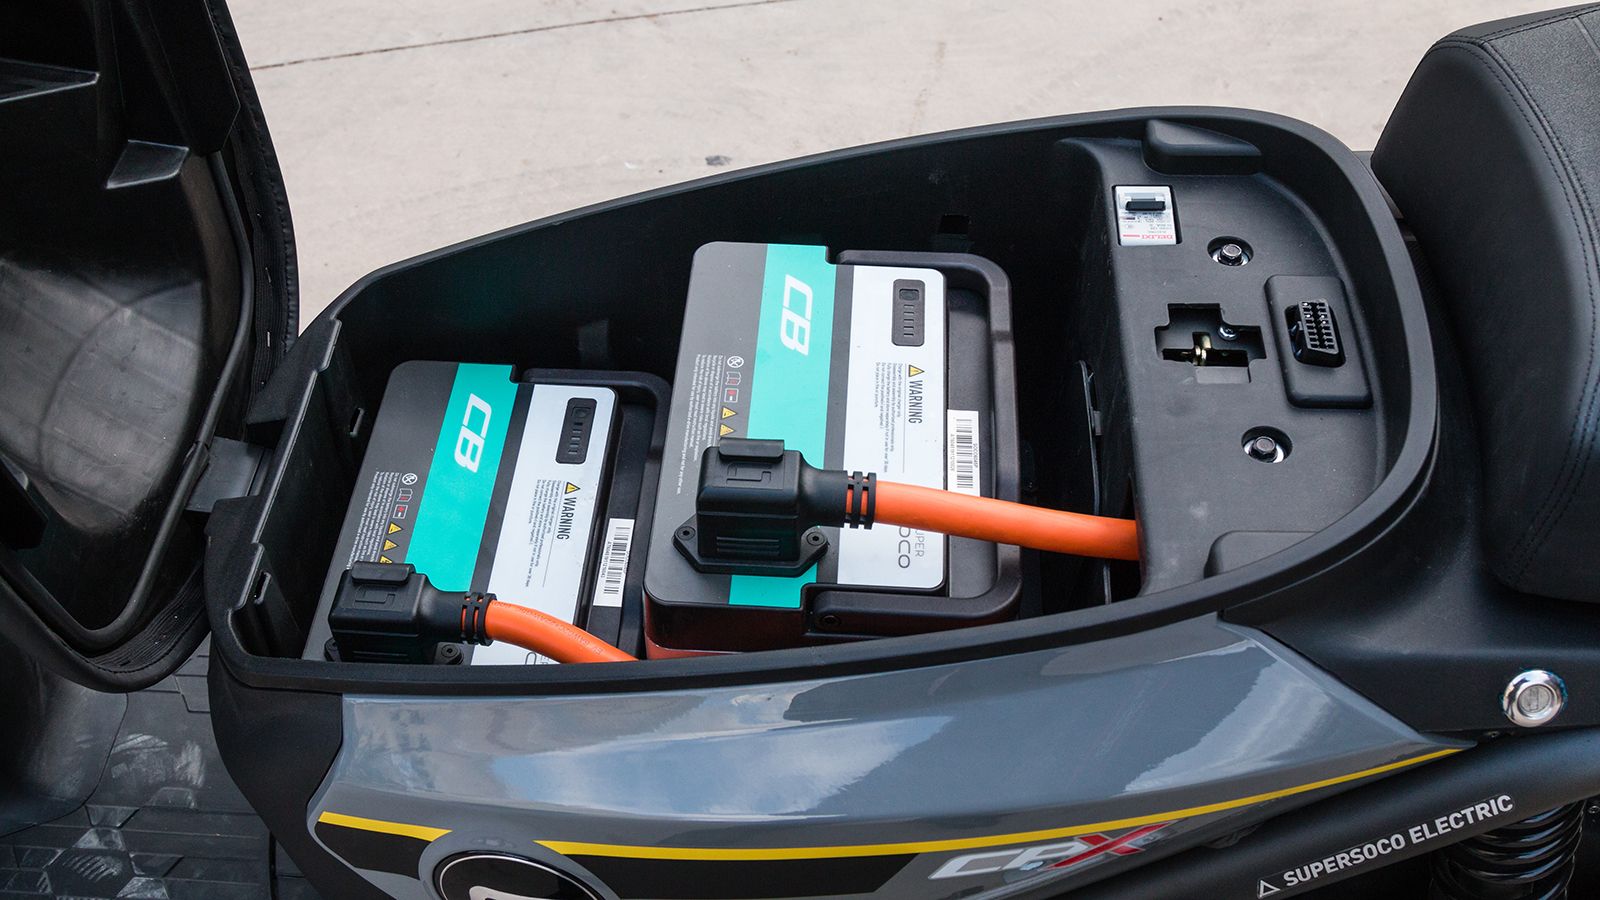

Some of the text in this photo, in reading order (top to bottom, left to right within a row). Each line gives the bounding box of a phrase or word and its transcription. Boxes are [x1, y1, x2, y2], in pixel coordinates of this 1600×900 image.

[780, 274, 814, 356] CB
[908, 380, 923, 424] WARNING
[454, 393, 492, 473] CB
[556, 497, 577, 540] WARNING
[898, 526, 911, 569] OCO
[914, 528, 925, 557] UPER
[1283, 794, 1515, 887] SUPERSOCO ELECTRIC
